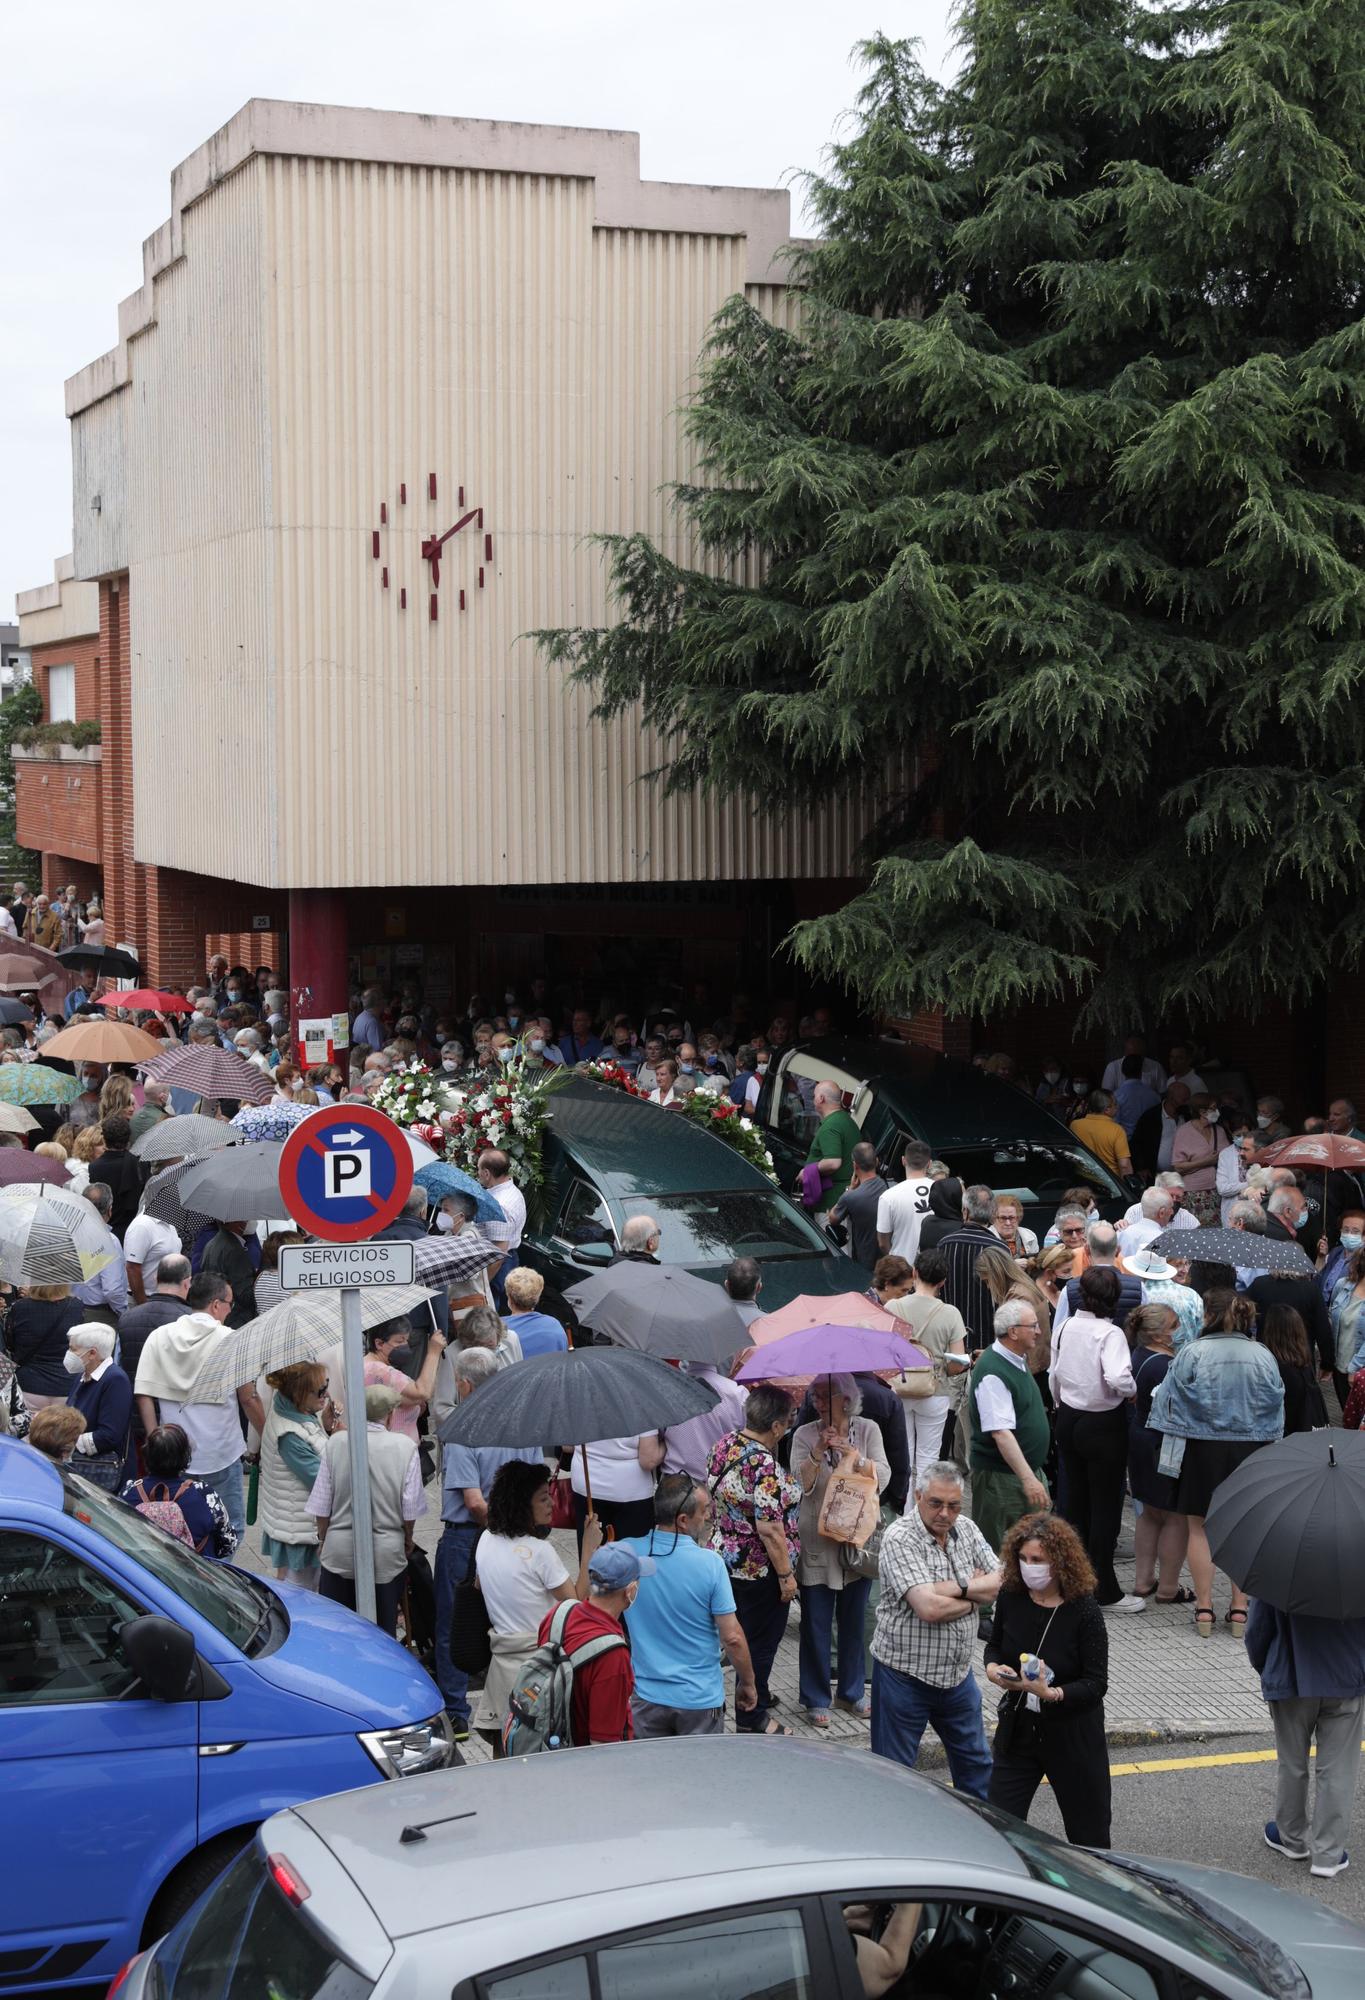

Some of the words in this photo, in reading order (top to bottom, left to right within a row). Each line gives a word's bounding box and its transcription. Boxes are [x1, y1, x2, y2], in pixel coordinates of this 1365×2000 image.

[333, 1154, 362, 1194] P
[302, 1248, 389, 1264] SERVICIOS
[298, 1270, 396, 1286] RELIGIOSOS
